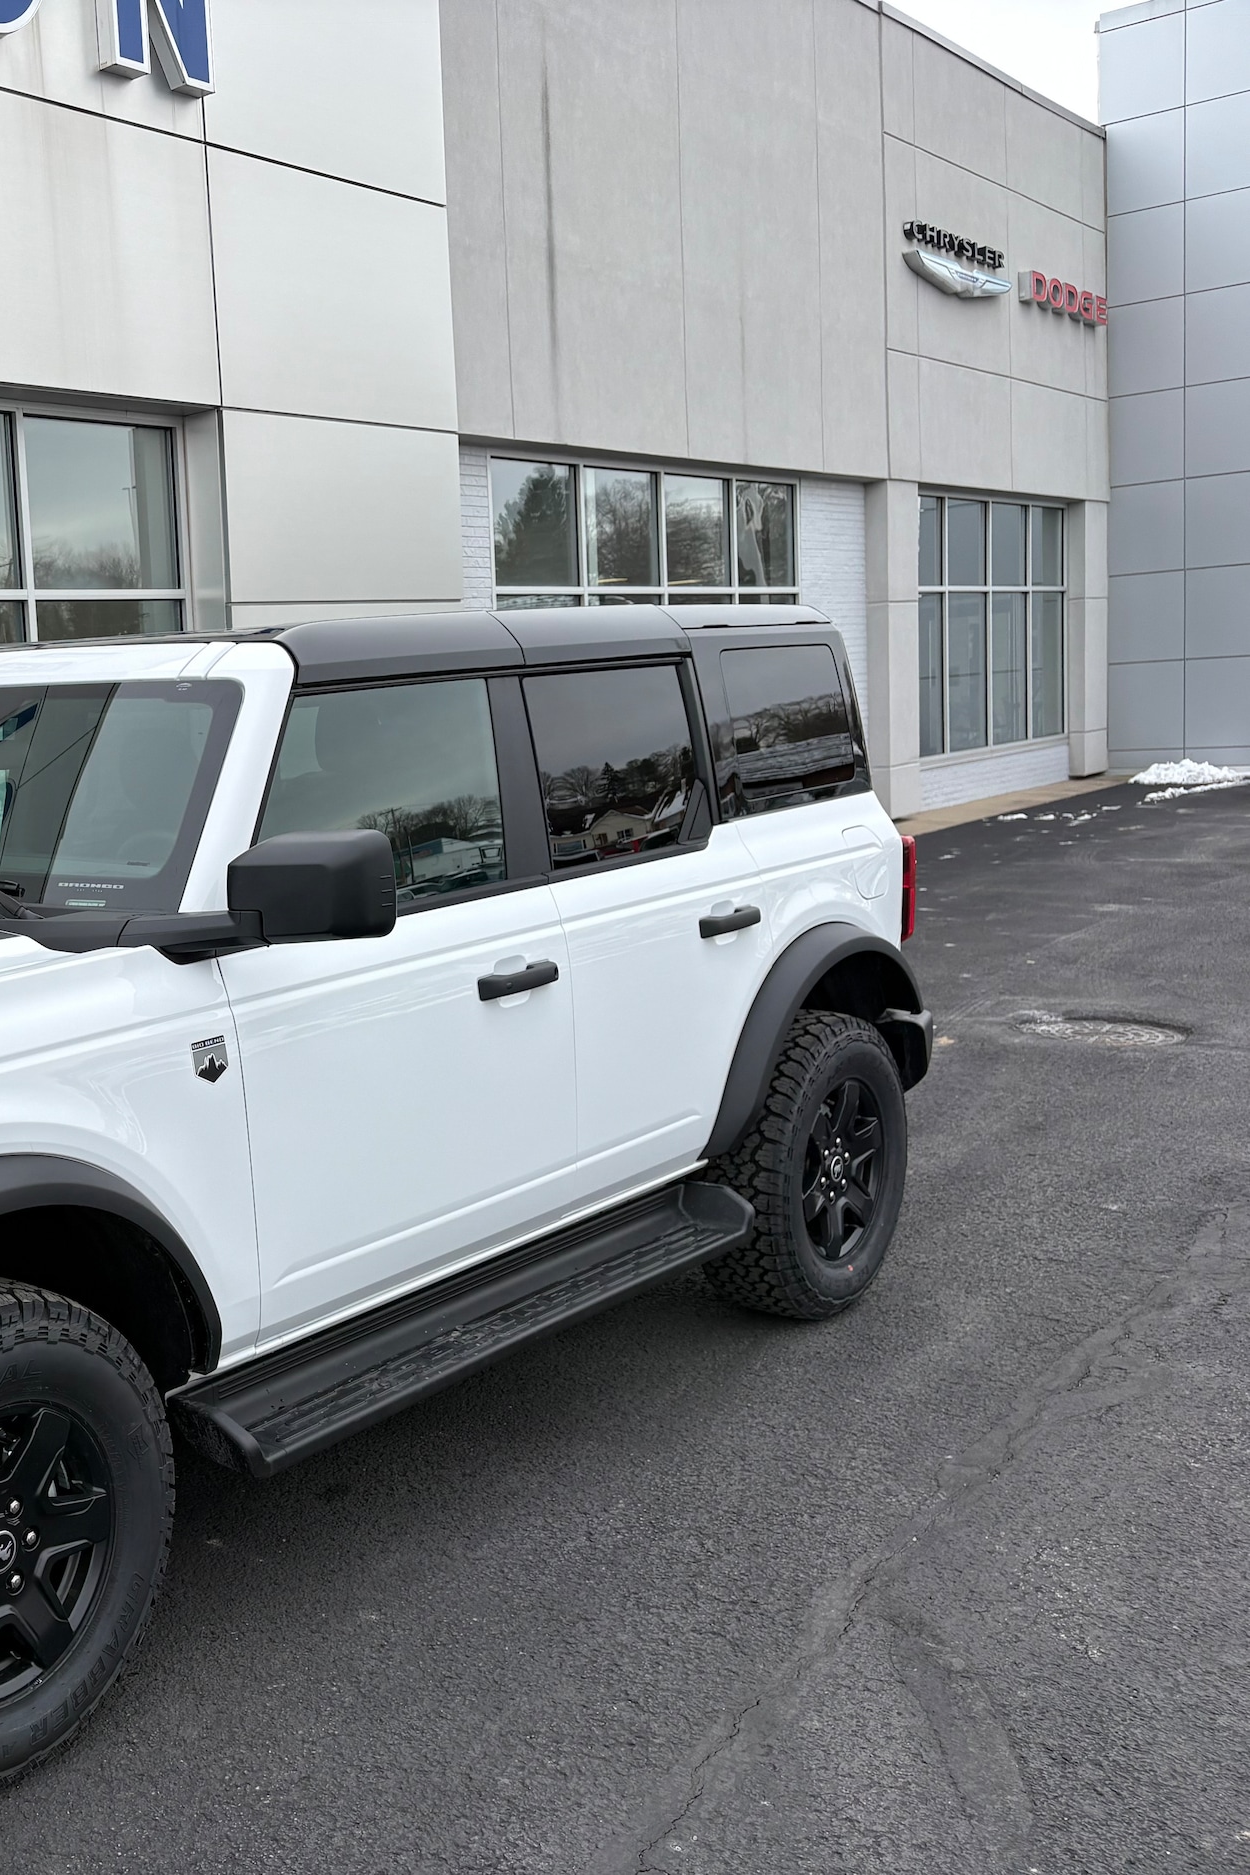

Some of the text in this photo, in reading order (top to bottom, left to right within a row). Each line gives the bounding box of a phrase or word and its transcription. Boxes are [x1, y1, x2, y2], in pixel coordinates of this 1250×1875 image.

[904, 219, 1005, 269] CHRYSLER
[1030, 269, 1109, 326] DODGE
[58, 882, 125, 890] BRONCO
[29, 1571, 146, 1746] GRABBER
